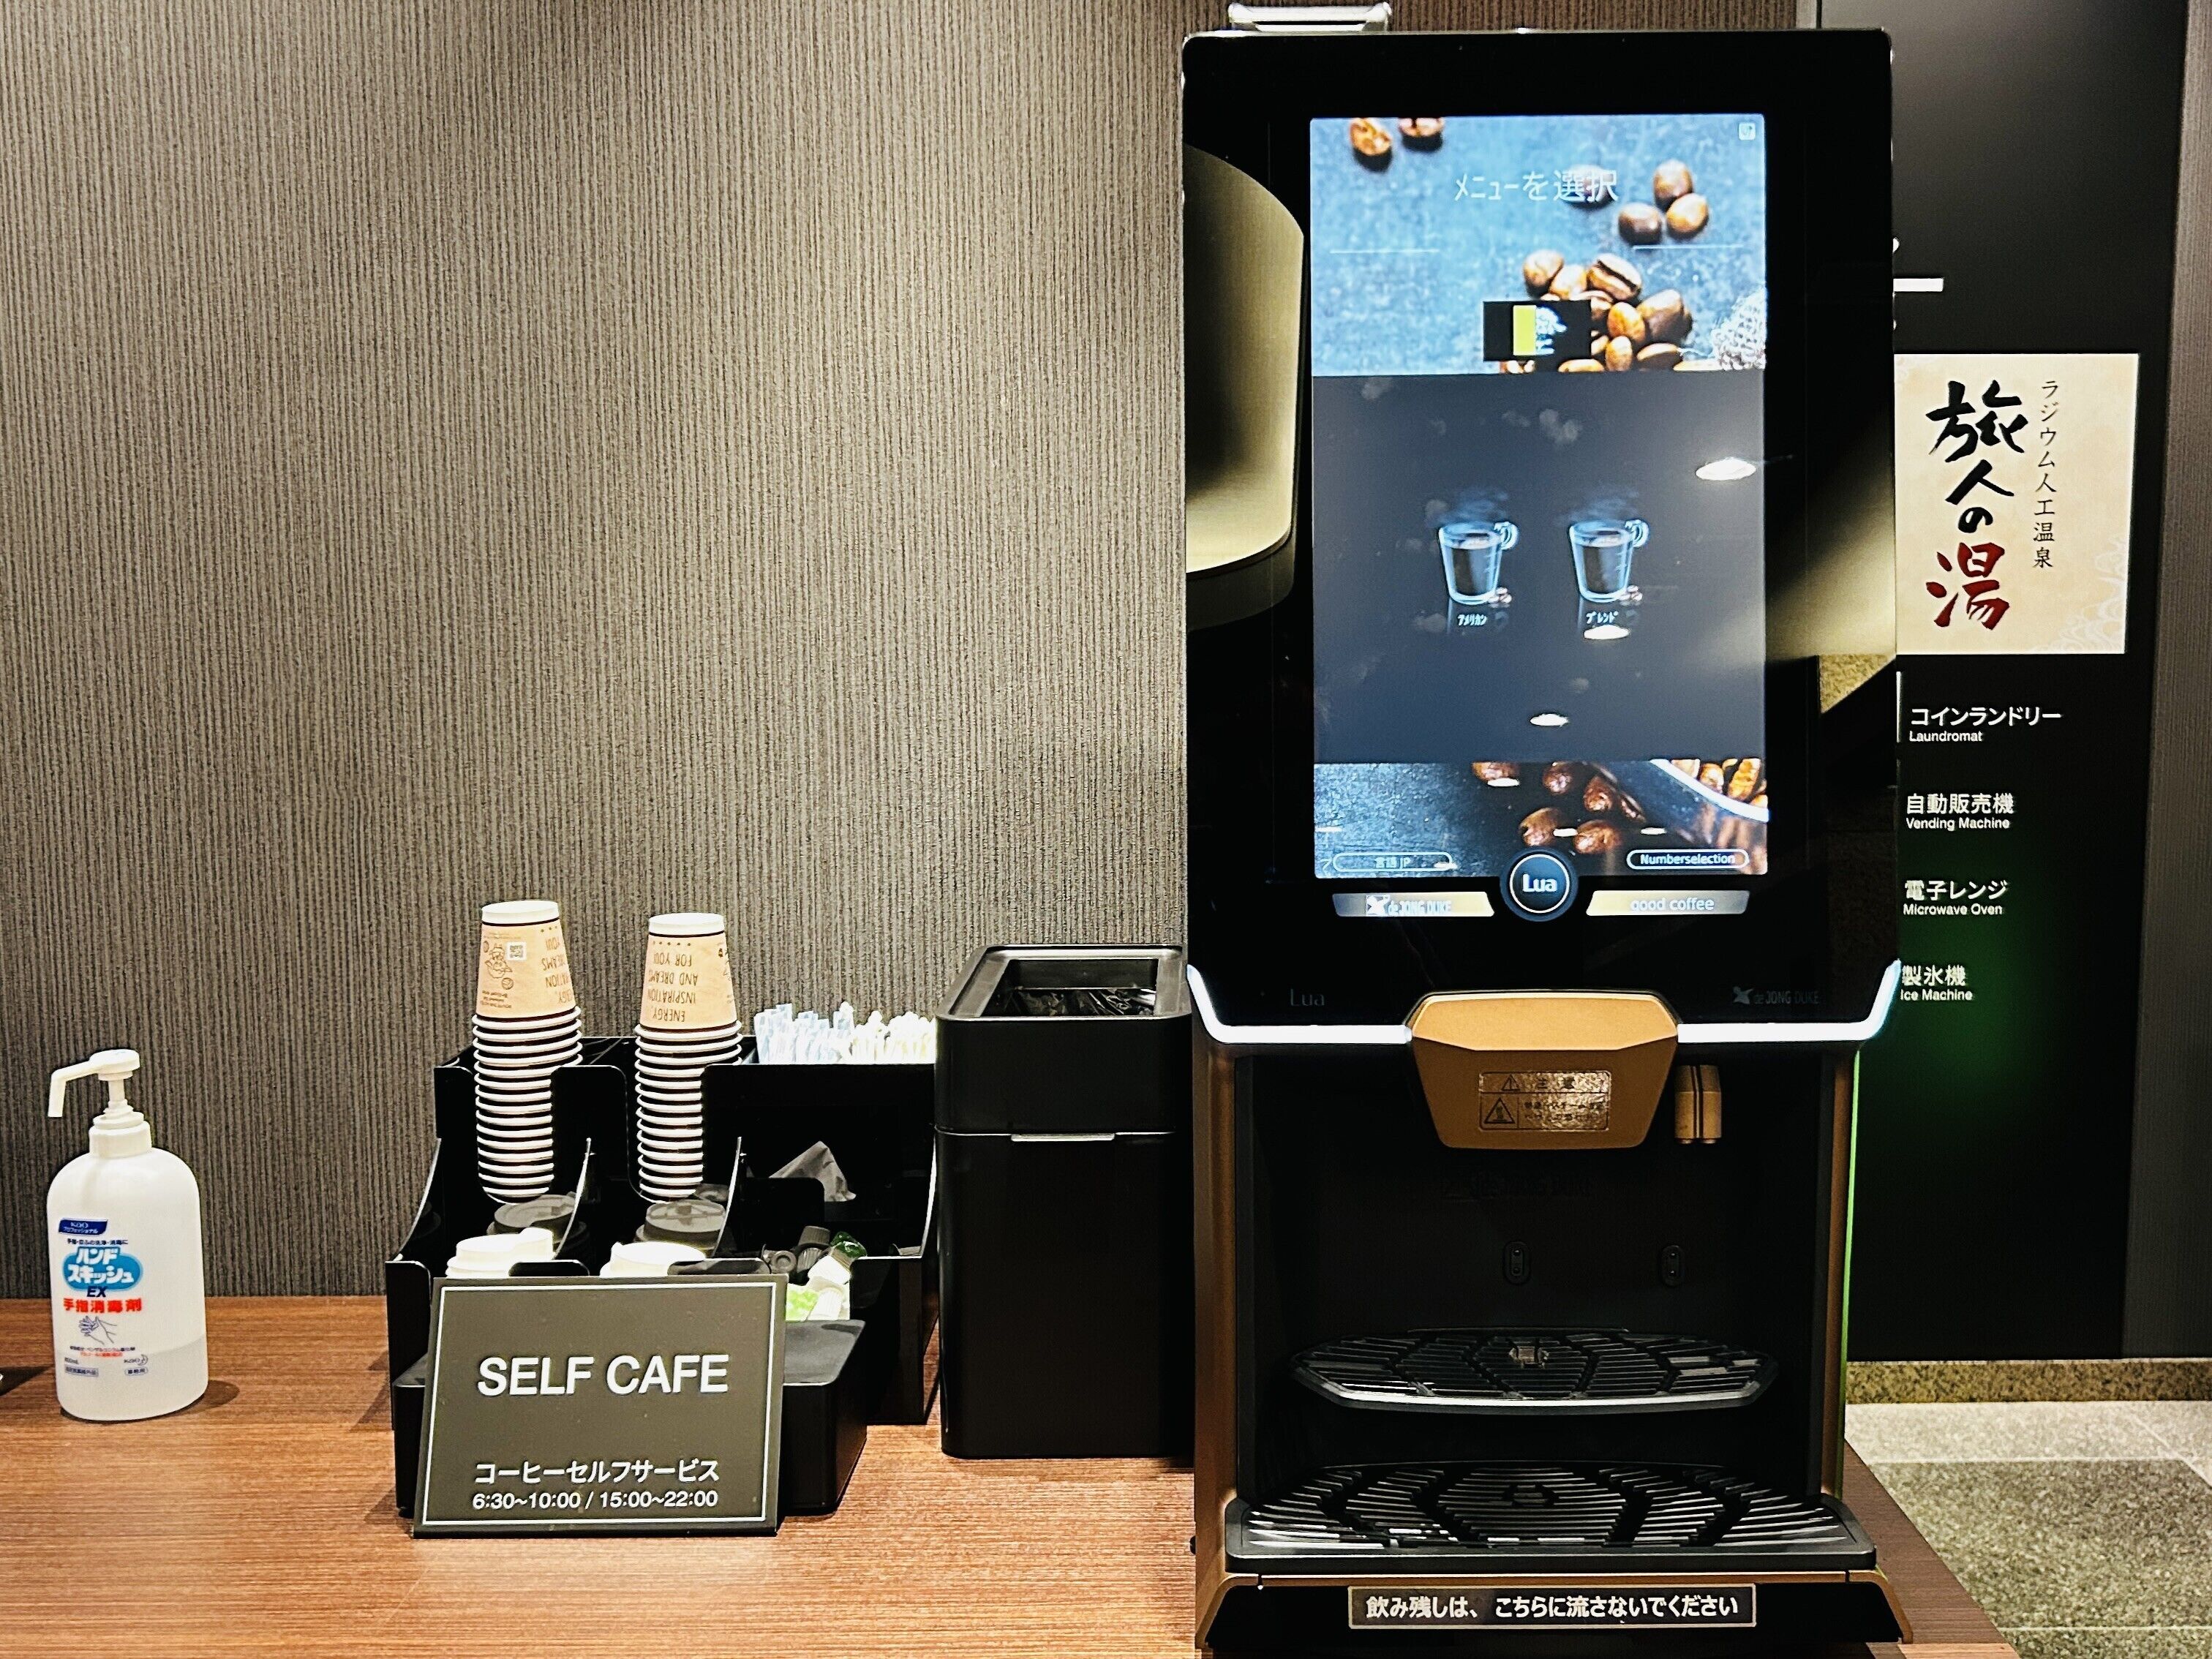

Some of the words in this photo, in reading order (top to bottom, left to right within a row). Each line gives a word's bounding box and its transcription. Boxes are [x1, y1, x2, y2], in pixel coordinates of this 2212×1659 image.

[1455, 170, 1618, 203] メニューを選択
[2033, 380, 2058, 568] ラジウム人工温泉
[1925, 380, 2028, 631] 旅人の湯
[1911, 707, 2061, 726] コインランドリー
[1909, 731, 1983, 742] Laundromat
[1906, 793, 2014, 814] 自動販売機
[1906, 818, 1955, 831] Vending
[1959, 818, 2010, 829] Machine
[1640, 854, 1736, 865] Numberselection
[1522, 873, 1558, 892] Lua
[1905, 880, 2008, 900] 電子レンジ
[1630, 898, 1665, 911] good
[1669, 898, 1715, 911] coffee
[1903, 903, 1968, 915] Microwave
[1971, 903, 2003, 915] Oven
[675, 954, 692, 966] FOR
[680, 972, 699, 986] AND
[1902, 965, 1966, 986] 製氷機
[1290, 988, 1325, 1006] Lua
[1766, 991, 1791, 1004] JONG
[1900, 989, 1918, 1001] Ice
[1922, 989, 1973, 1001] Machine
[76, 1248, 118, 1265] ハンド
[67, 1264, 135, 1284] スキッシュ
[86, 1285, 108, 1298] EX
[477, 1356, 595, 1396] SELF
[606, 1354, 729, 1395] CAFE
[475, 1458, 720, 1484] コーヒーセルフサービス
[1366, 1595, 1478, 1619] 飲み残しは、
[1494, 1595, 1739, 1619] こちらに流さないでください
